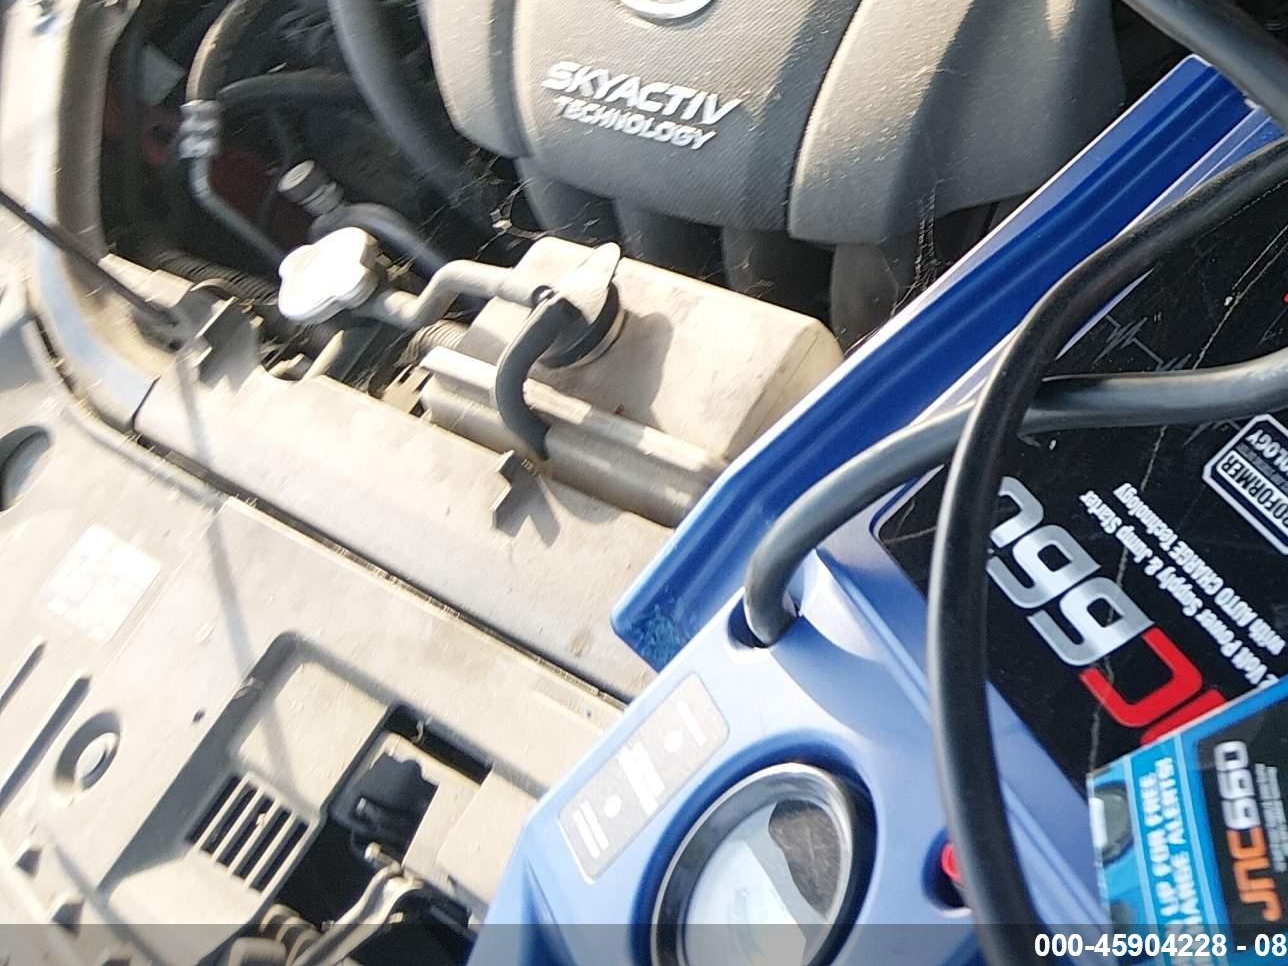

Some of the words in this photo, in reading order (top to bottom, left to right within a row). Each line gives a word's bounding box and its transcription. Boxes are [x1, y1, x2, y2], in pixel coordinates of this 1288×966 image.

[541, 61, 743, 125] SKYACTIV
[553, 95, 717, 150] TECHNOLOGY
[1079, 490, 1122, 533] Starter
[1113, 483, 1178, 551] Technology
[1115, 525, 1152, 563] Jump
[1144, 556, 1163, 575] &
[1168, 541, 1224, 595] CHARGE
[1155, 566, 1203, 616] Supply
[1214, 587, 1258, 628] AUTO
[1195, 609, 1242, 657] Power
[1248, 618, 1286, 655] with
[1231, 647, 1268, 685] Volt
[1139, 772, 1163, 826] FREE
[1147, 828, 1171, 877] FOR
